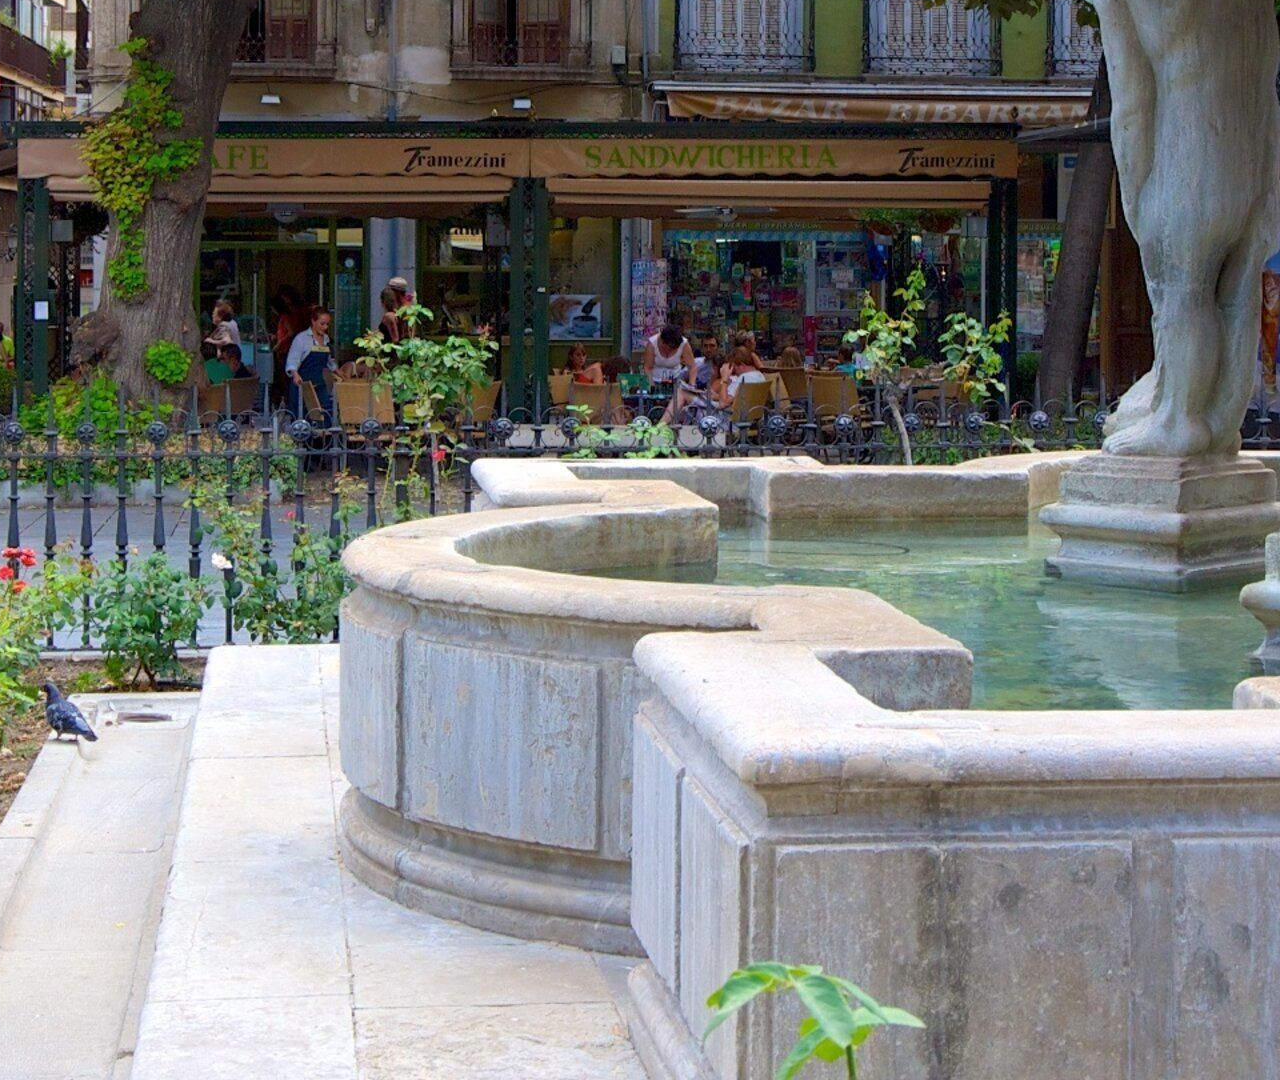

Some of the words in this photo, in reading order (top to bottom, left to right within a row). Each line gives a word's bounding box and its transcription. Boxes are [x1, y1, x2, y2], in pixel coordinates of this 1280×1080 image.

[713, 97, 849, 120] BAZAR
[403, 146, 507, 173] Tramezzini
[584, 144, 839, 170] SANDWICHERIA
[898, 147, 996, 174] Tramezzini
